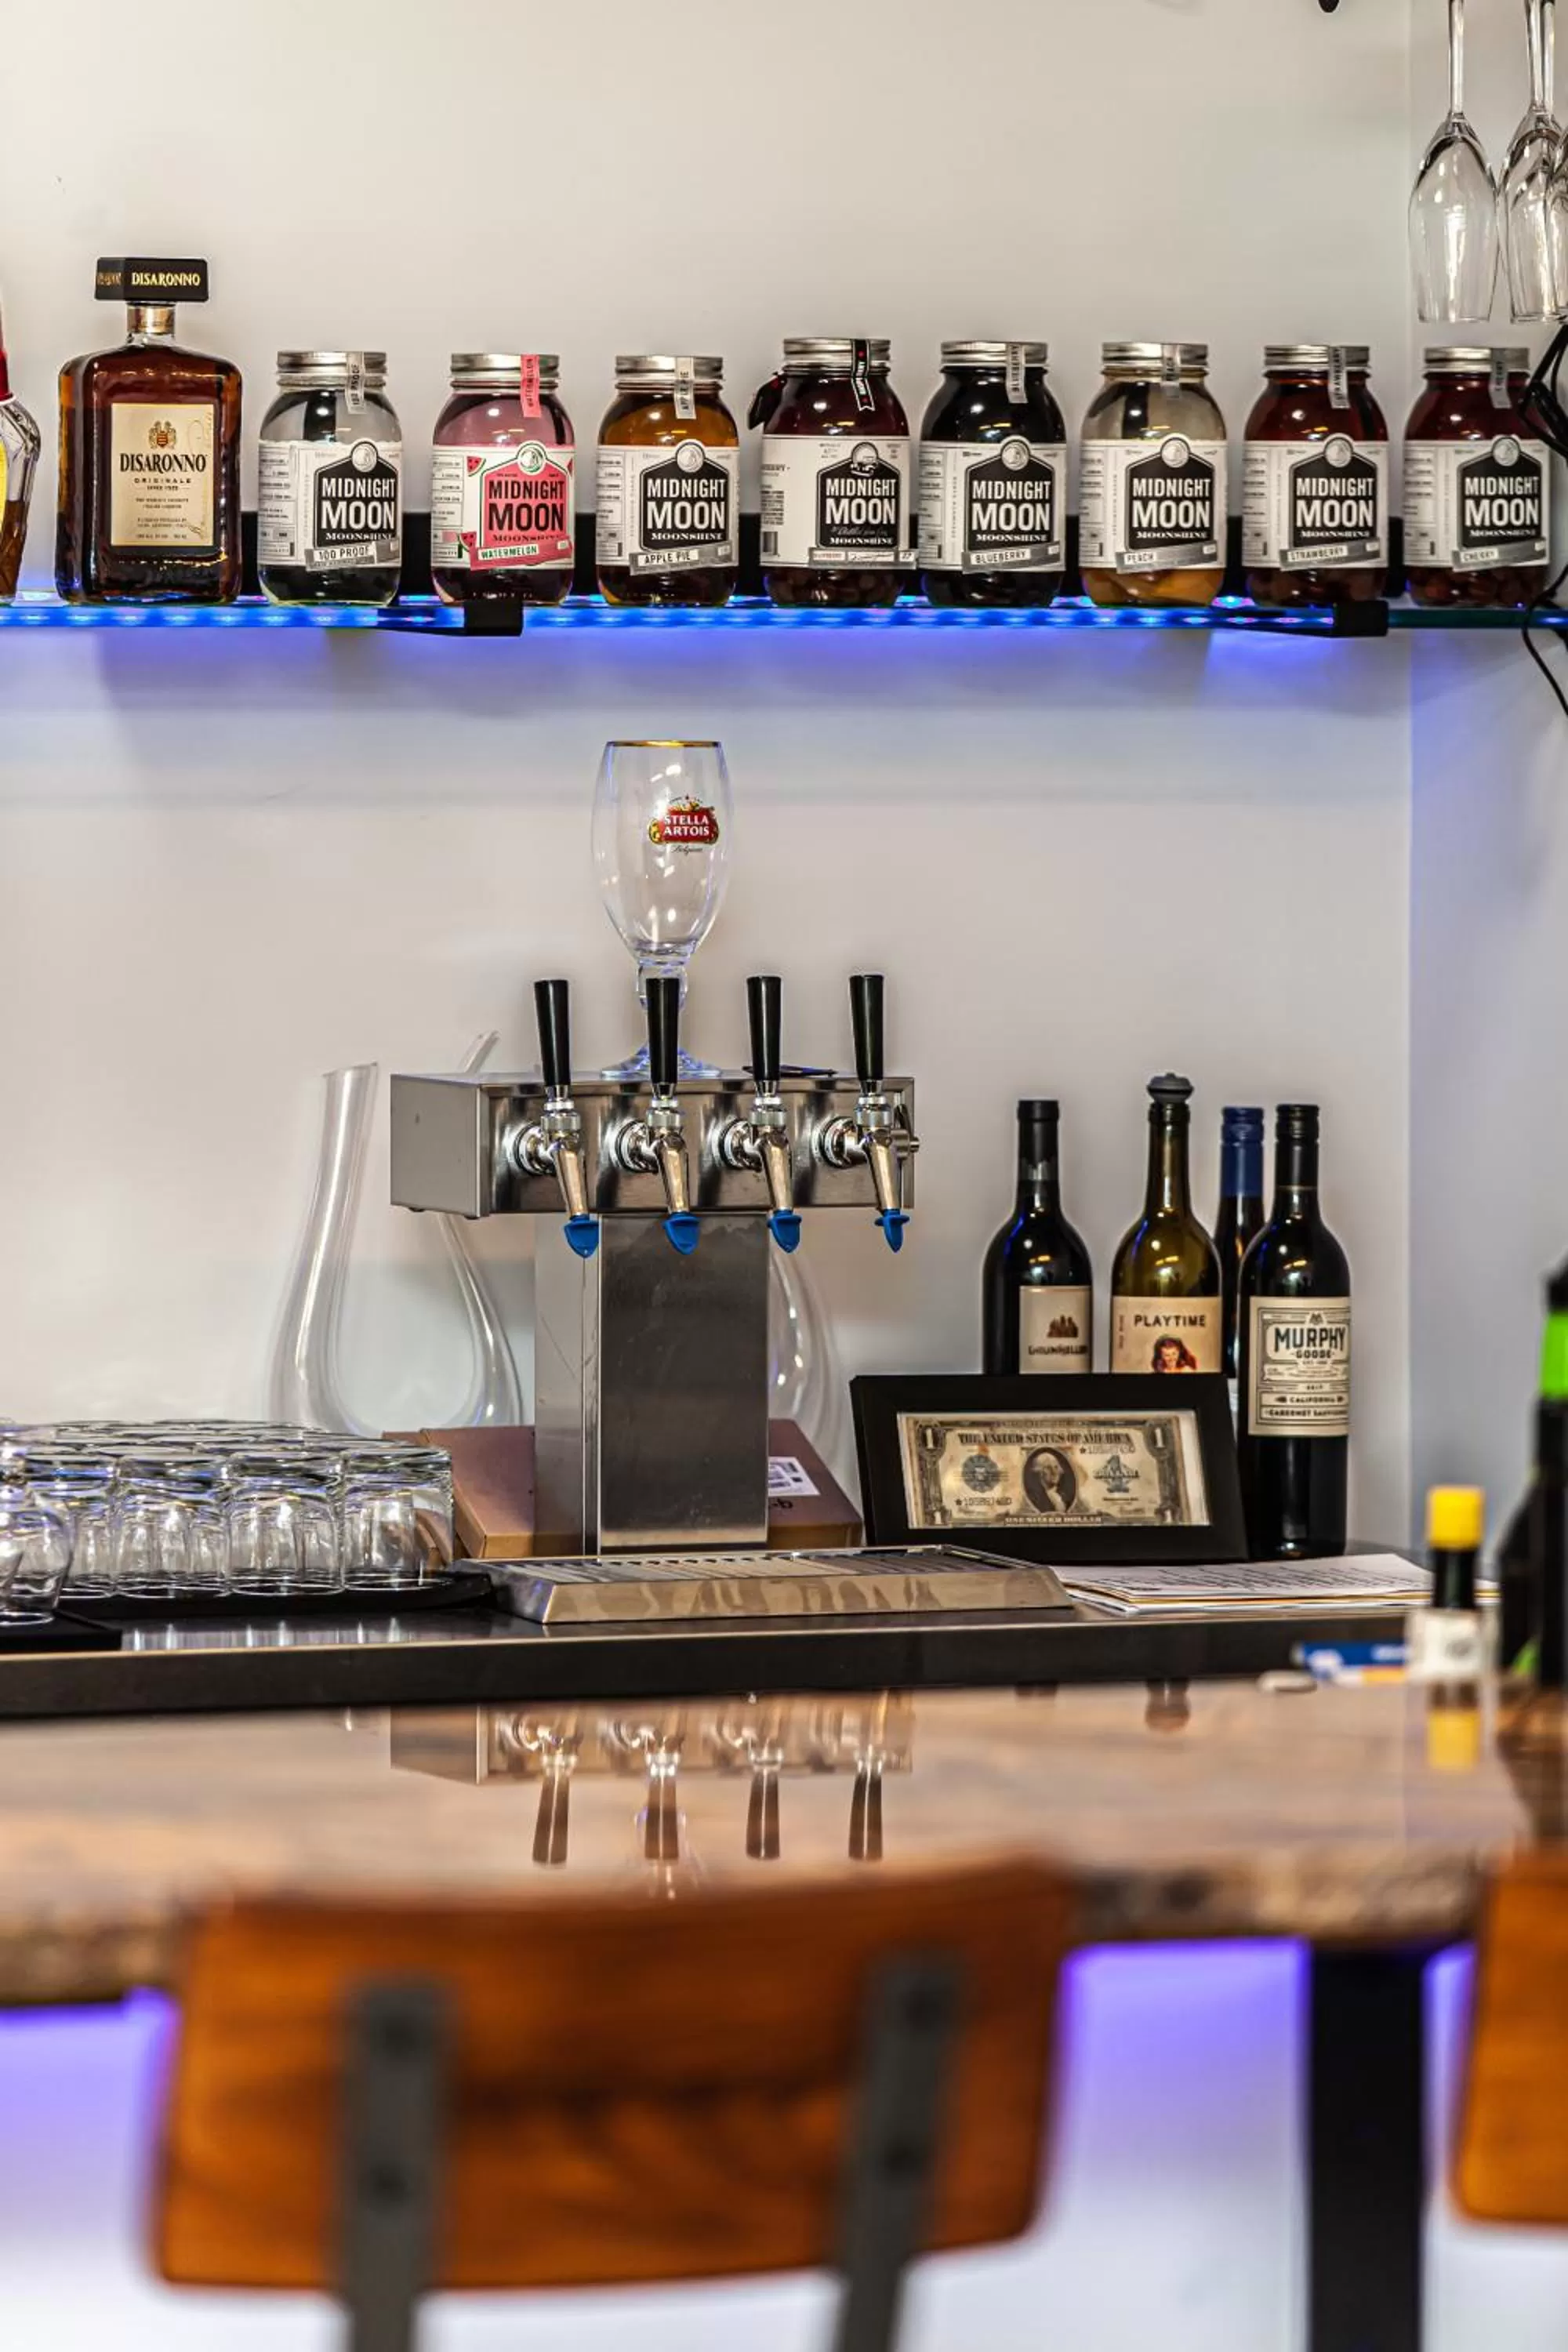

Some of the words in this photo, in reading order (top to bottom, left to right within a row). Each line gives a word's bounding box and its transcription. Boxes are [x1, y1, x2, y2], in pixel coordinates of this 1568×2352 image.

[131, 272, 201, 287] DISARONNO
[120, 452, 206, 474] DISARONNO
[321, 477, 395, 498] MIDNIGHT
[488, 480, 564, 499] MIDNIGHT
[647, 478, 725, 498] MIDNIGHT
[826, 477, 896, 496] MIDNIGHT
[972, 480, 1051, 499] MIDNIGHT
[1133, 477, 1211, 497] MIDNIGHT
[1296, 477, 1374, 496] MIDNIGHT
[1465, 477, 1539, 495] MIDNIGHT
[321, 500, 394, 530] MOON
[488, 503, 564, 532] MOON
[647, 501, 725, 529] MOON
[826, 498, 895, 524] MOON
[972, 503, 1051, 531] MOON
[1132, 499, 1210, 528] MOON
[1296, 499, 1374, 528] MOON
[1465, 498, 1539, 527] MOON
[481, 545, 537, 559] WATERMELON
[645, 552, 673, 564] APPLE
[975, 550, 1026, 564] BLUEBERRY
[1127, 553, 1153, 563] PEACH
[1290, 547, 1344, 561] STRAWBERRY
[664, 815, 710, 826] STELLA
[663, 826, 710, 837] ARTOIS
[1134, 1315, 1206, 1327] PLAYTIME
[1274, 1327, 1346, 1353] MURPHY
[957, 1432, 980, 1443] THE
[982, 1432, 1023, 1443] UNITED
[1025, 1432, 1065, 1443] STATES
[1083, 1432, 1134, 1443] AMERICA
